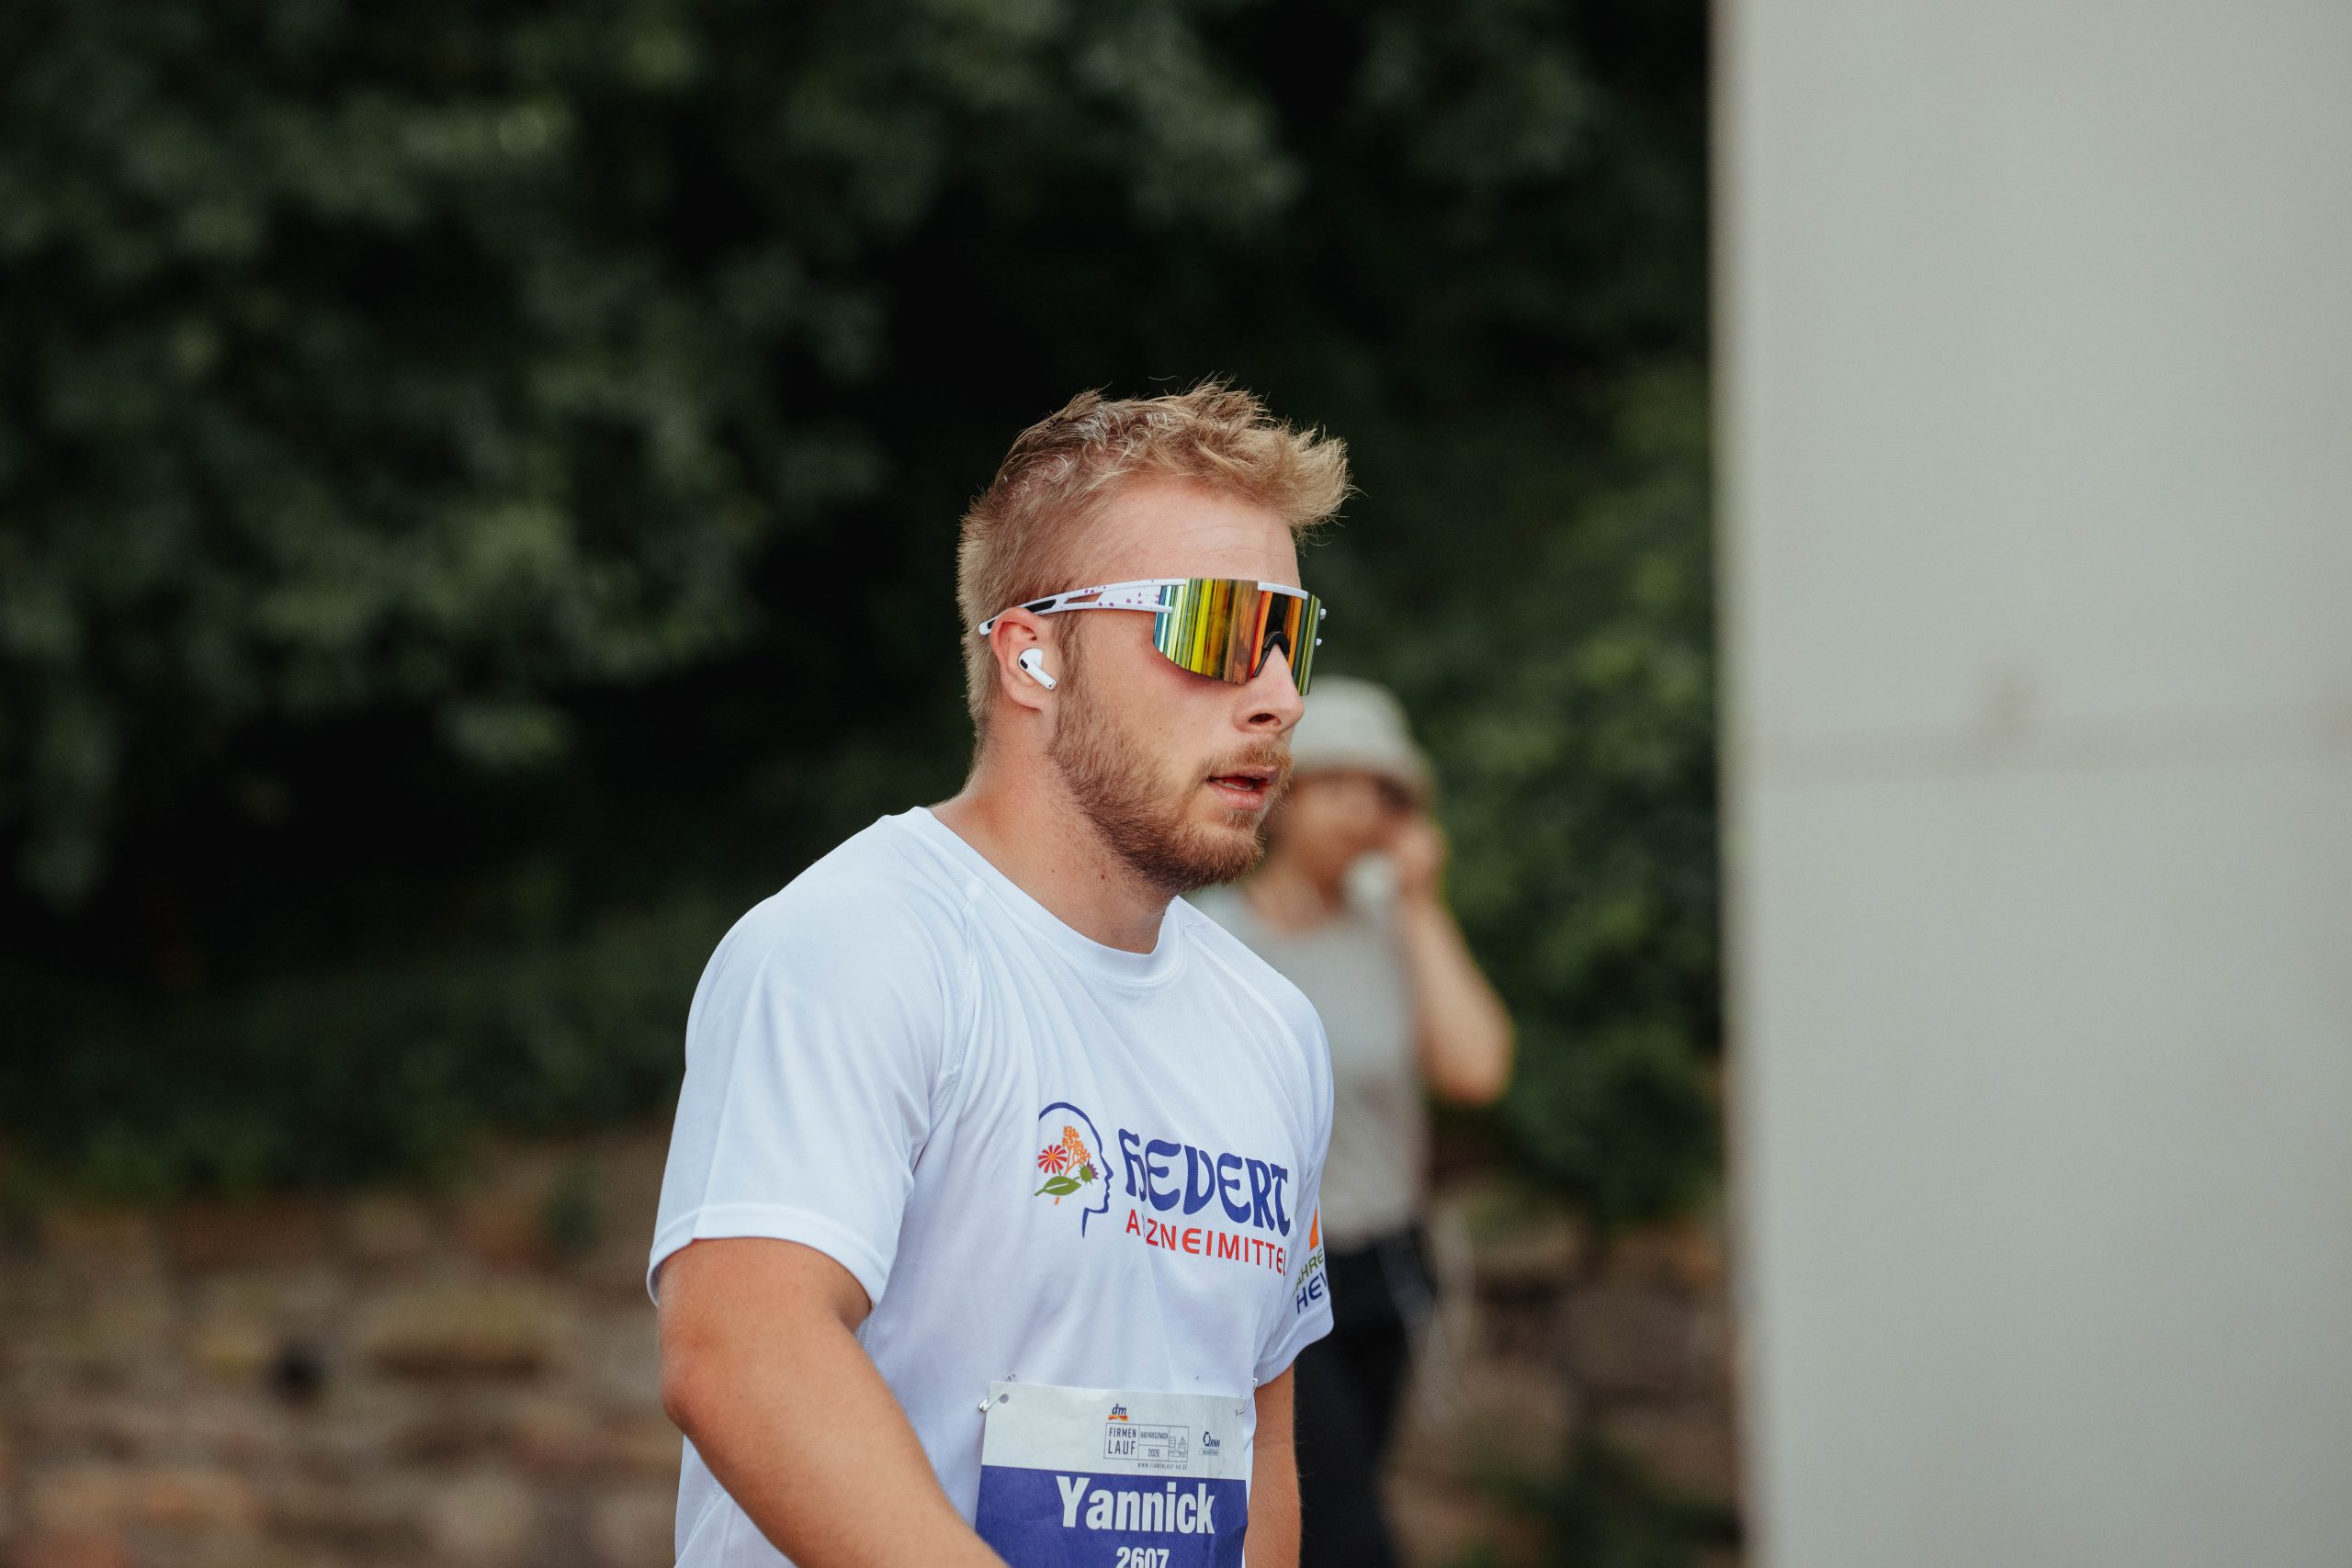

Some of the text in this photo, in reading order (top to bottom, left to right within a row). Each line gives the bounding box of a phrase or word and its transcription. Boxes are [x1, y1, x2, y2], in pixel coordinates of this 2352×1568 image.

[1125, 1208, 1286, 1277] AZNEIMITTEL
[1292, 1247, 1324, 1298] AHRE
[1112, 1404, 1127, 1416] dm
[1109, 1427, 1136, 1438] FIRMEN
[1108, 1439, 1136, 1455] LAUF
[1056, 1475, 1216, 1535] Yannick
[1115, 1546, 1170, 1568] 2607
